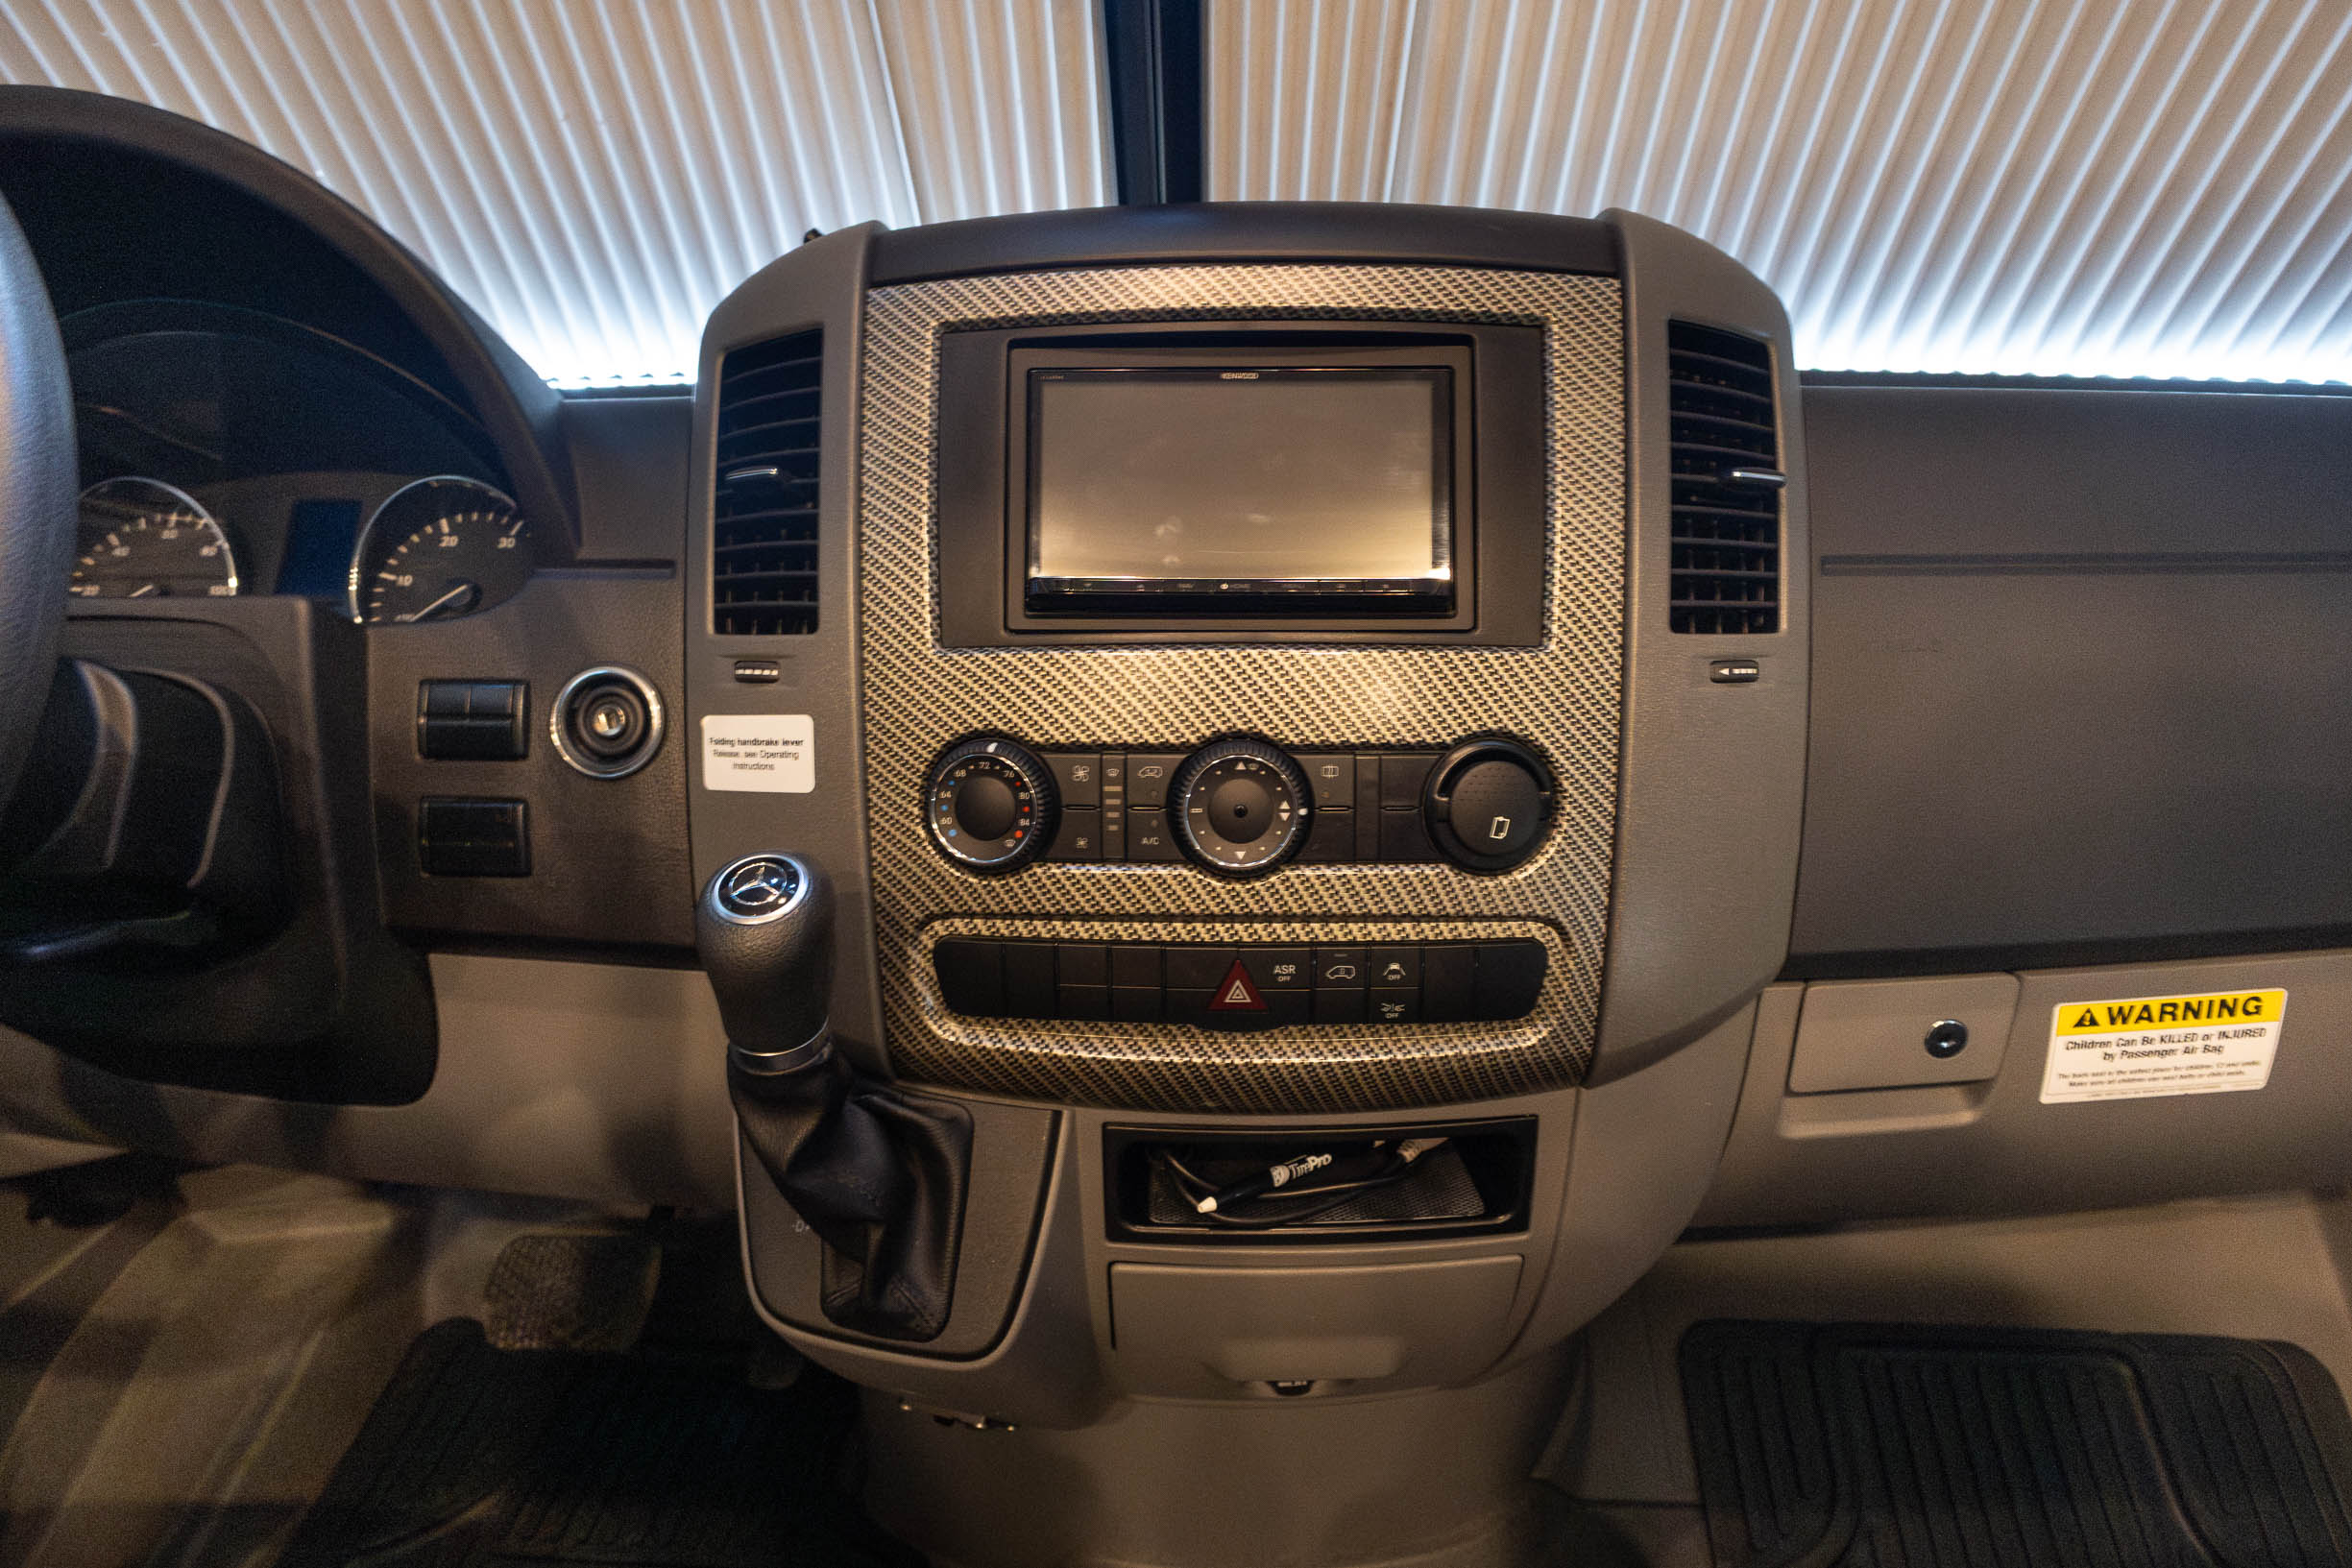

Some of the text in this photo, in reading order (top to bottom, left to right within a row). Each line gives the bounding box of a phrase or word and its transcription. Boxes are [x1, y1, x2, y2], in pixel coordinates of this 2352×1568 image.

[438, 535, 459, 547] 20
[497, 537, 516, 548] 30
[709, 736, 804, 747] Folding handbrake lever
[760, 750, 799, 760] Operating
[940, 790, 952, 799] 64
[1018, 791, 1031, 800] 80
[940, 816, 953, 825] 60
[1019, 818, 1031, 827] 84
[1141, 836, 1160, 845] A/C
[1273, 964, 1297, 975] ASR
[2107, 997, 2263, 1026] WARNING
[2066, 1039, 2112, 1051] Children
[2116, 1037, 2138, 1048] Can
[2141, 1036, 2155, 1046] Be
[2159, 1032, 2198, 1045] KILLED
[2218, 1027, 2267, 1040] INJURED
[2103, 1044, 2224, 1062] by Passenger Air Bag
